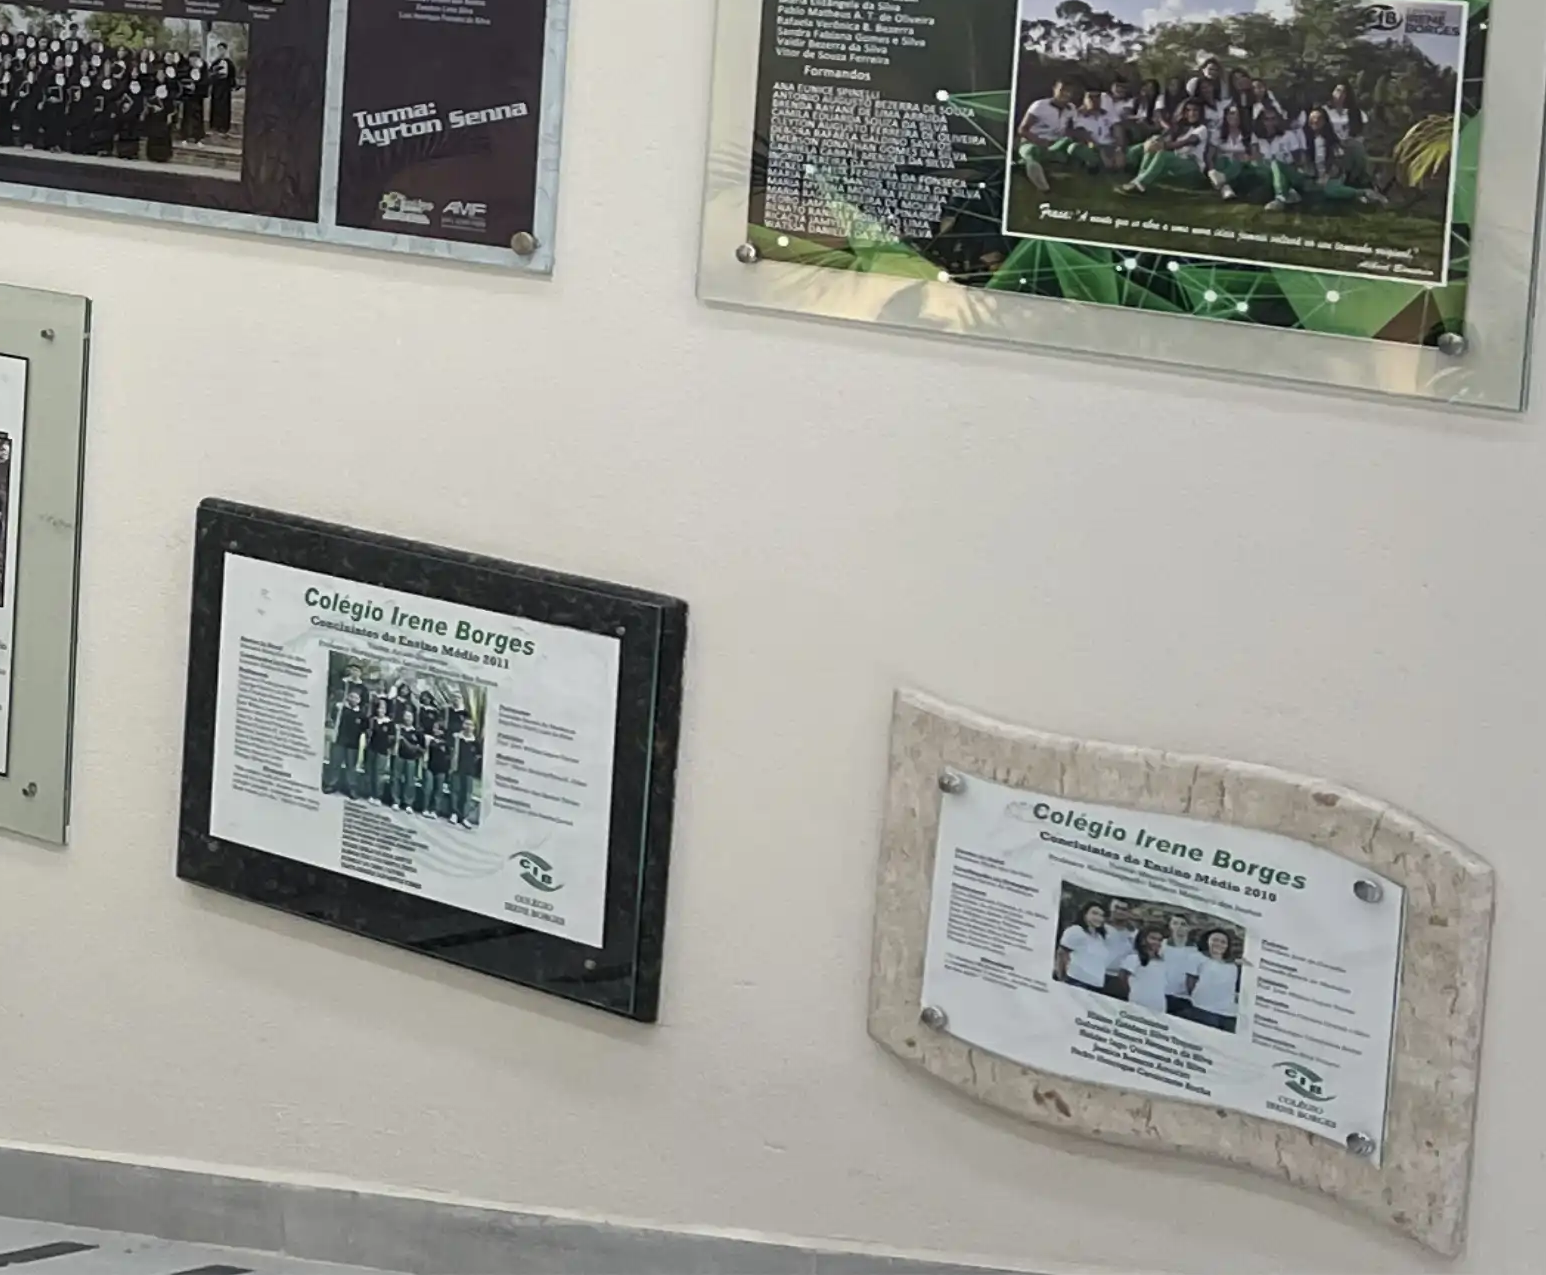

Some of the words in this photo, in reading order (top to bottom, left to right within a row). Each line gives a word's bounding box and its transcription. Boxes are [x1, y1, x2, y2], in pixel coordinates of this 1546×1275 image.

[804, 65, 871, 81] Formandos
[353, 101, 437, 128] Turma:
[358, 118, 442, 147] Ayrton
[449, 101, 530, 128] Senna
[304, 587, 384, 622] Colégio
[391, 606, 449, 637] Irene
[455, 620, 536, 657] Borges
[382, 633, 396, 645] do
[398, 634, 439, 655] Ensino
[441, 644, 480, 663] Médio
[482, 653, 510, 670] 2011
[1033, 802, 1126, 842] Colégio
[1136, 829, 1204, 862] Irene
[1212, 849, 1306, 890] Borges
[1124, 853, 1140, 866] do
[1143, 859, 1191, 879] Ensino
[1194, 870, 1242, 892] Médio
[1244, 884, 1277, 902] 2010
